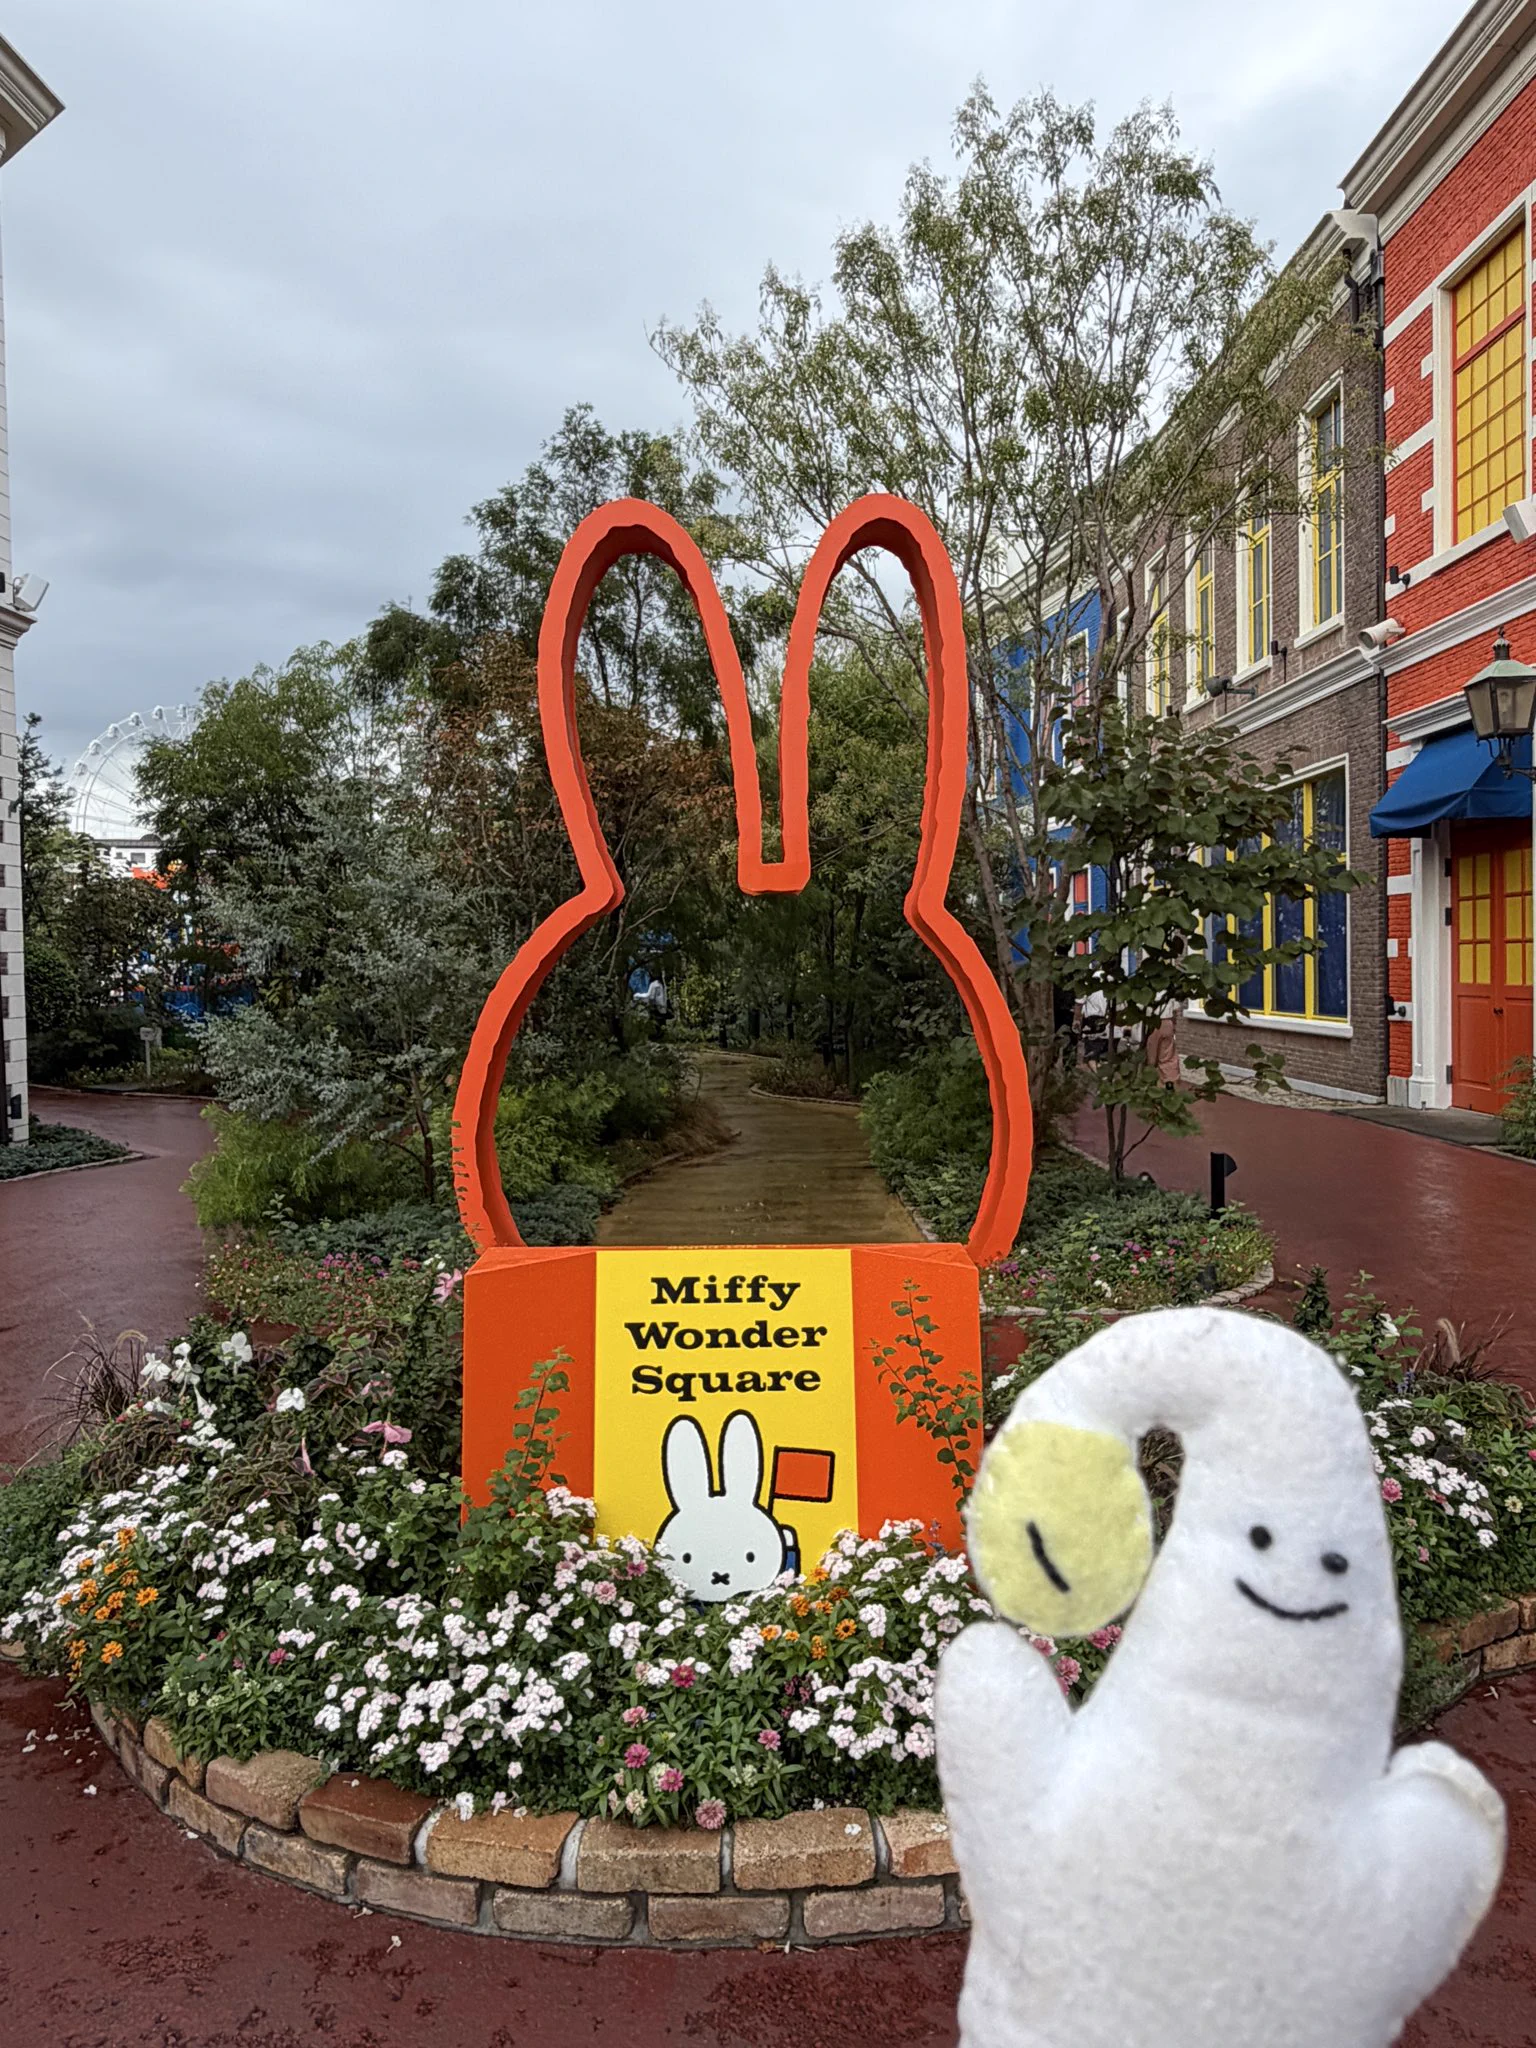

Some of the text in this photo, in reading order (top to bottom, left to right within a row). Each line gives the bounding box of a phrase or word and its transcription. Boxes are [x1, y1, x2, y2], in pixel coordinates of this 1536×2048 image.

[650, 1274, 801, 1312] Miffy
[624, 1320, 828, 1350] Wonder
[631, 1364, 821, 1402] Square
